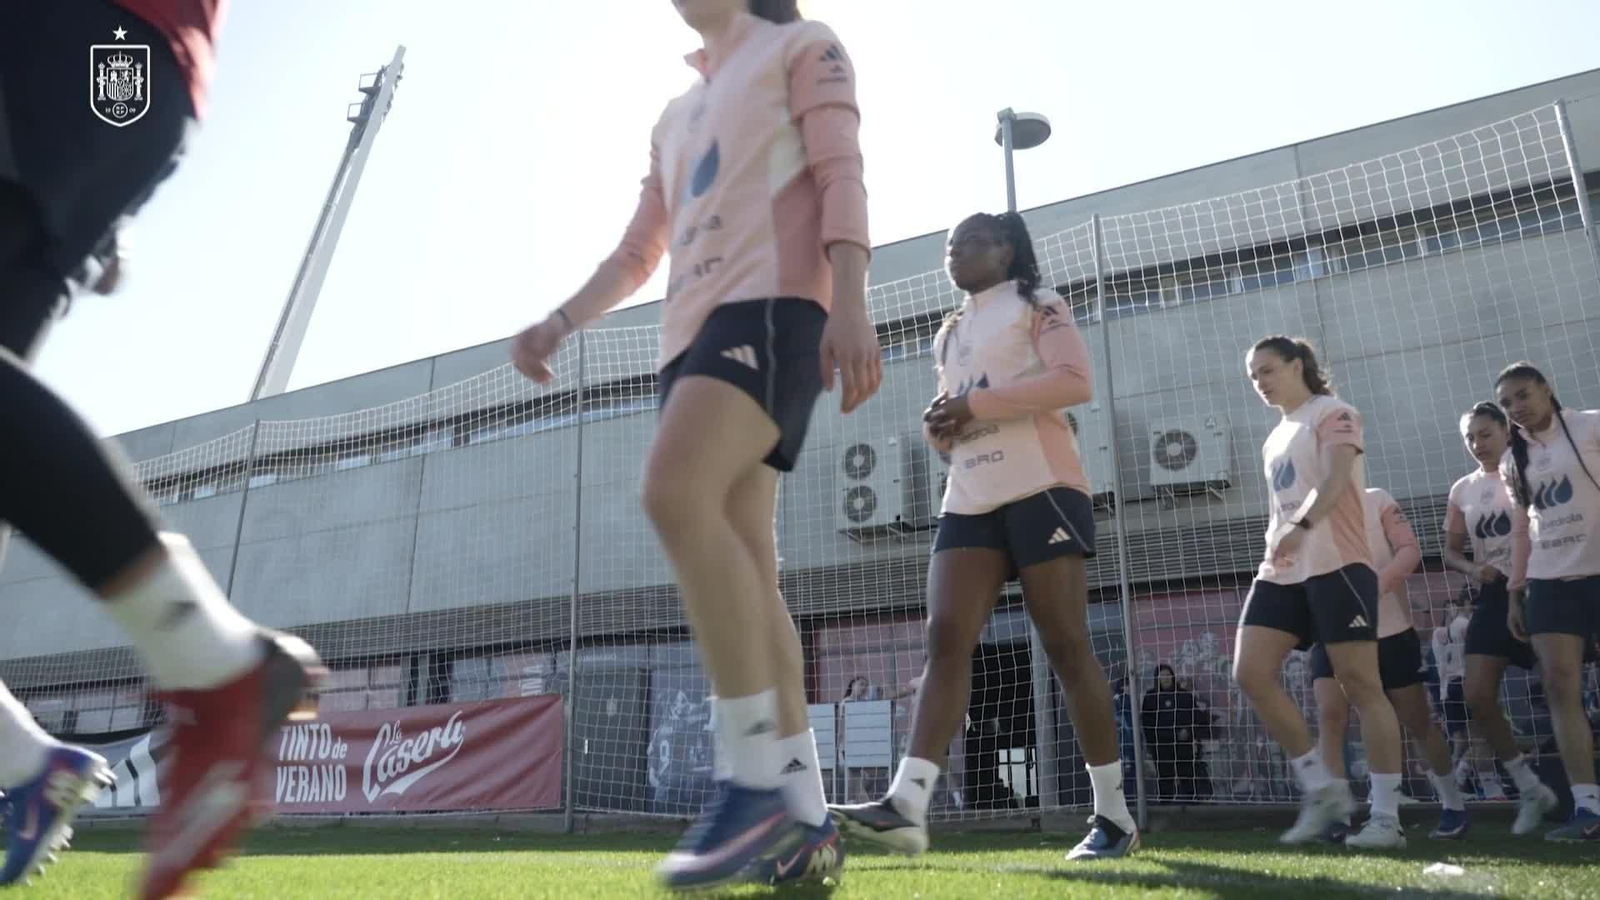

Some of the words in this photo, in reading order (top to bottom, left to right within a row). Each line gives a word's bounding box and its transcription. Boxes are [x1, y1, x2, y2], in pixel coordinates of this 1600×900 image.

[279, 723, 332, 761] TINTO
[331, 736, 348, 760] de
[362, 710, 466, 804] Casera
[275, 764, 347, 803] VERANO
